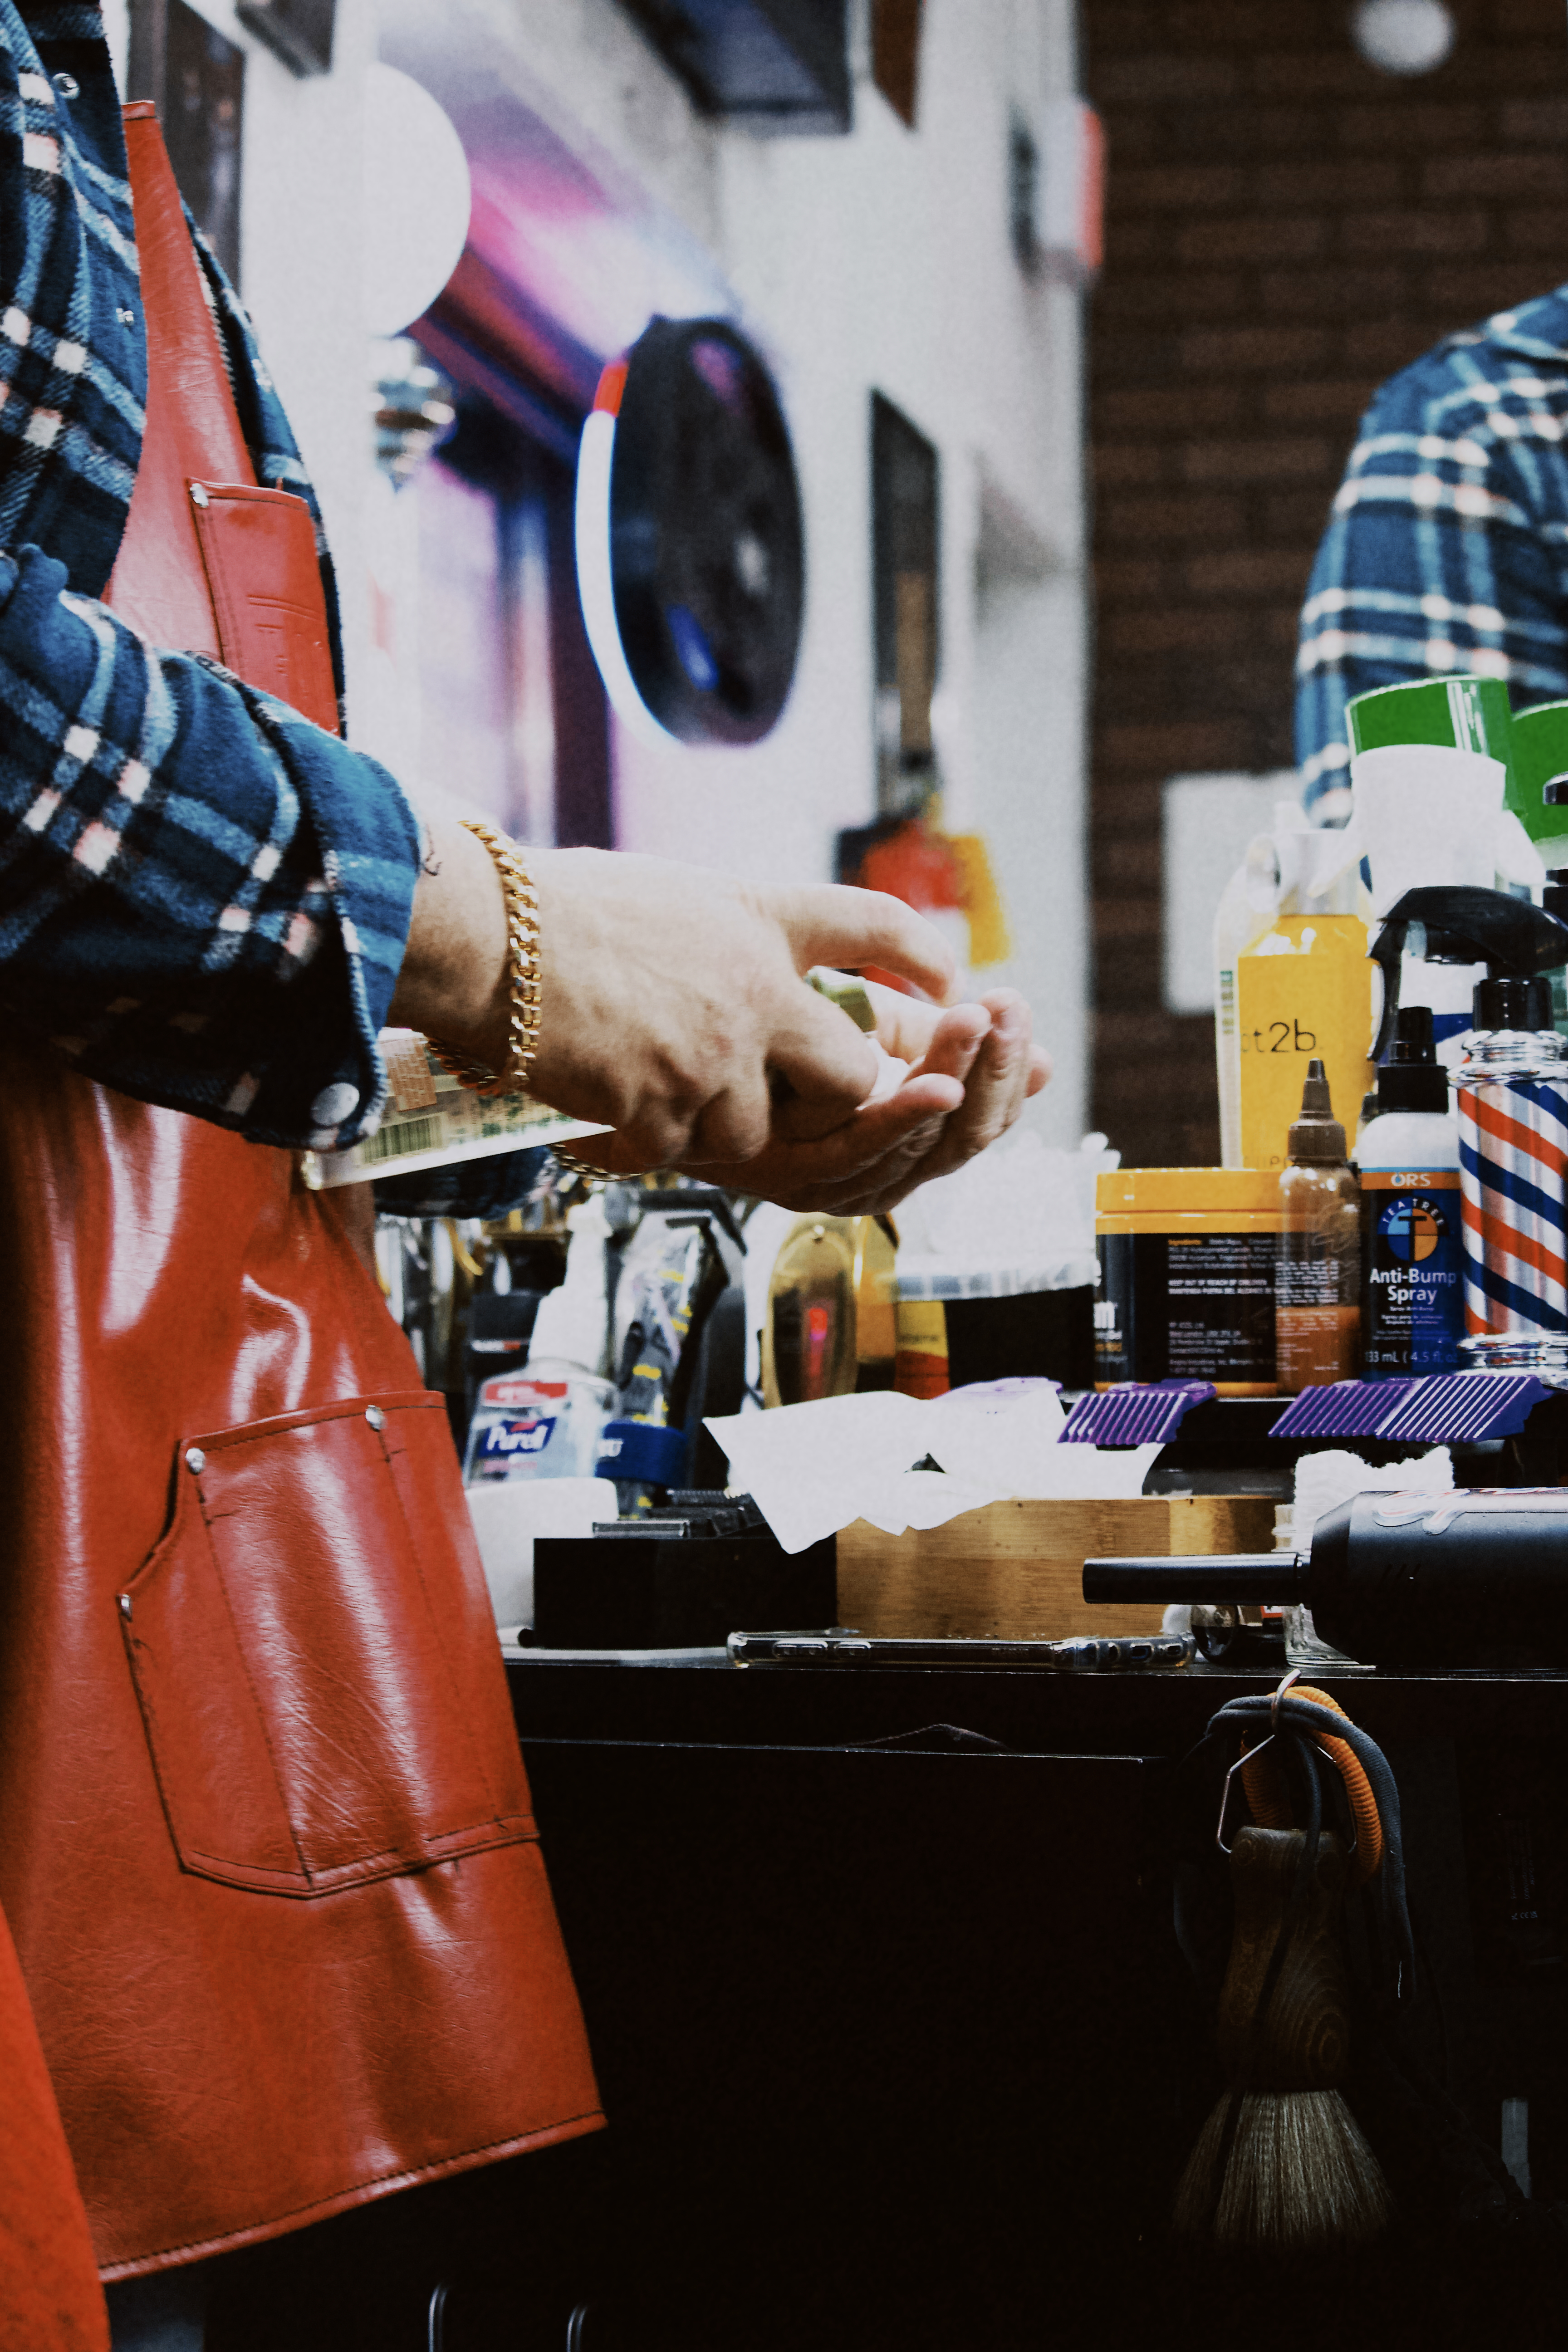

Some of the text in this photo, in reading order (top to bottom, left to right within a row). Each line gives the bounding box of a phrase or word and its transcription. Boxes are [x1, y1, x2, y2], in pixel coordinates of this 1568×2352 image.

[1391, 1173, 1431, 1187] ORS
[1369, 1267, 1457, 1288] Anti-Bump
[1387, 1285, 1438, 1305] Spray
